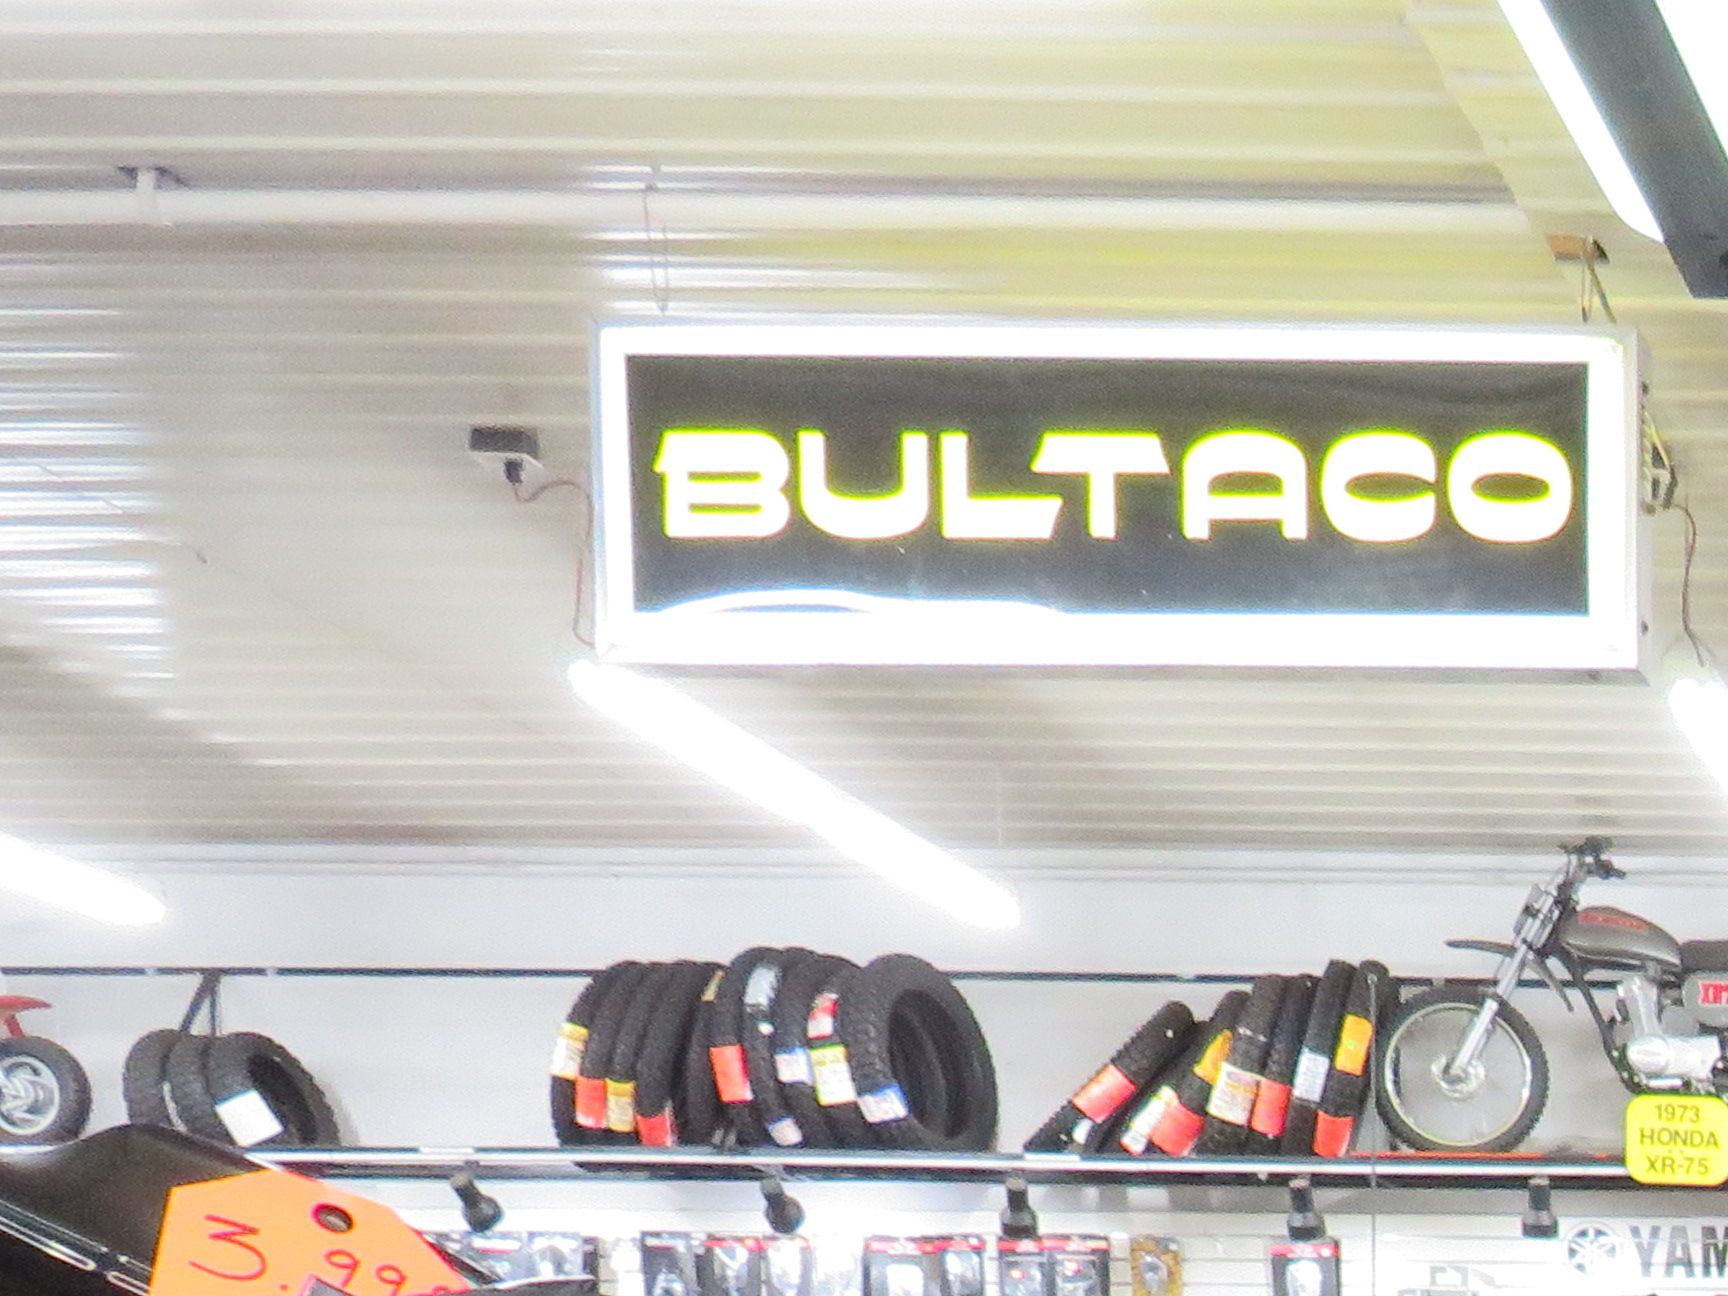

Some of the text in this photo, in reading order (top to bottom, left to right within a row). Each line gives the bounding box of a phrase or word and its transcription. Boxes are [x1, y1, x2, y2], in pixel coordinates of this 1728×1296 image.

[653, 428, 1574, 543] BULTACO
[1655, 1103, 1701, 1124] 1973
[1639, 1127, 1719, 1149] HONDA
[1646, 1155, 1709, 1176] XR-75
